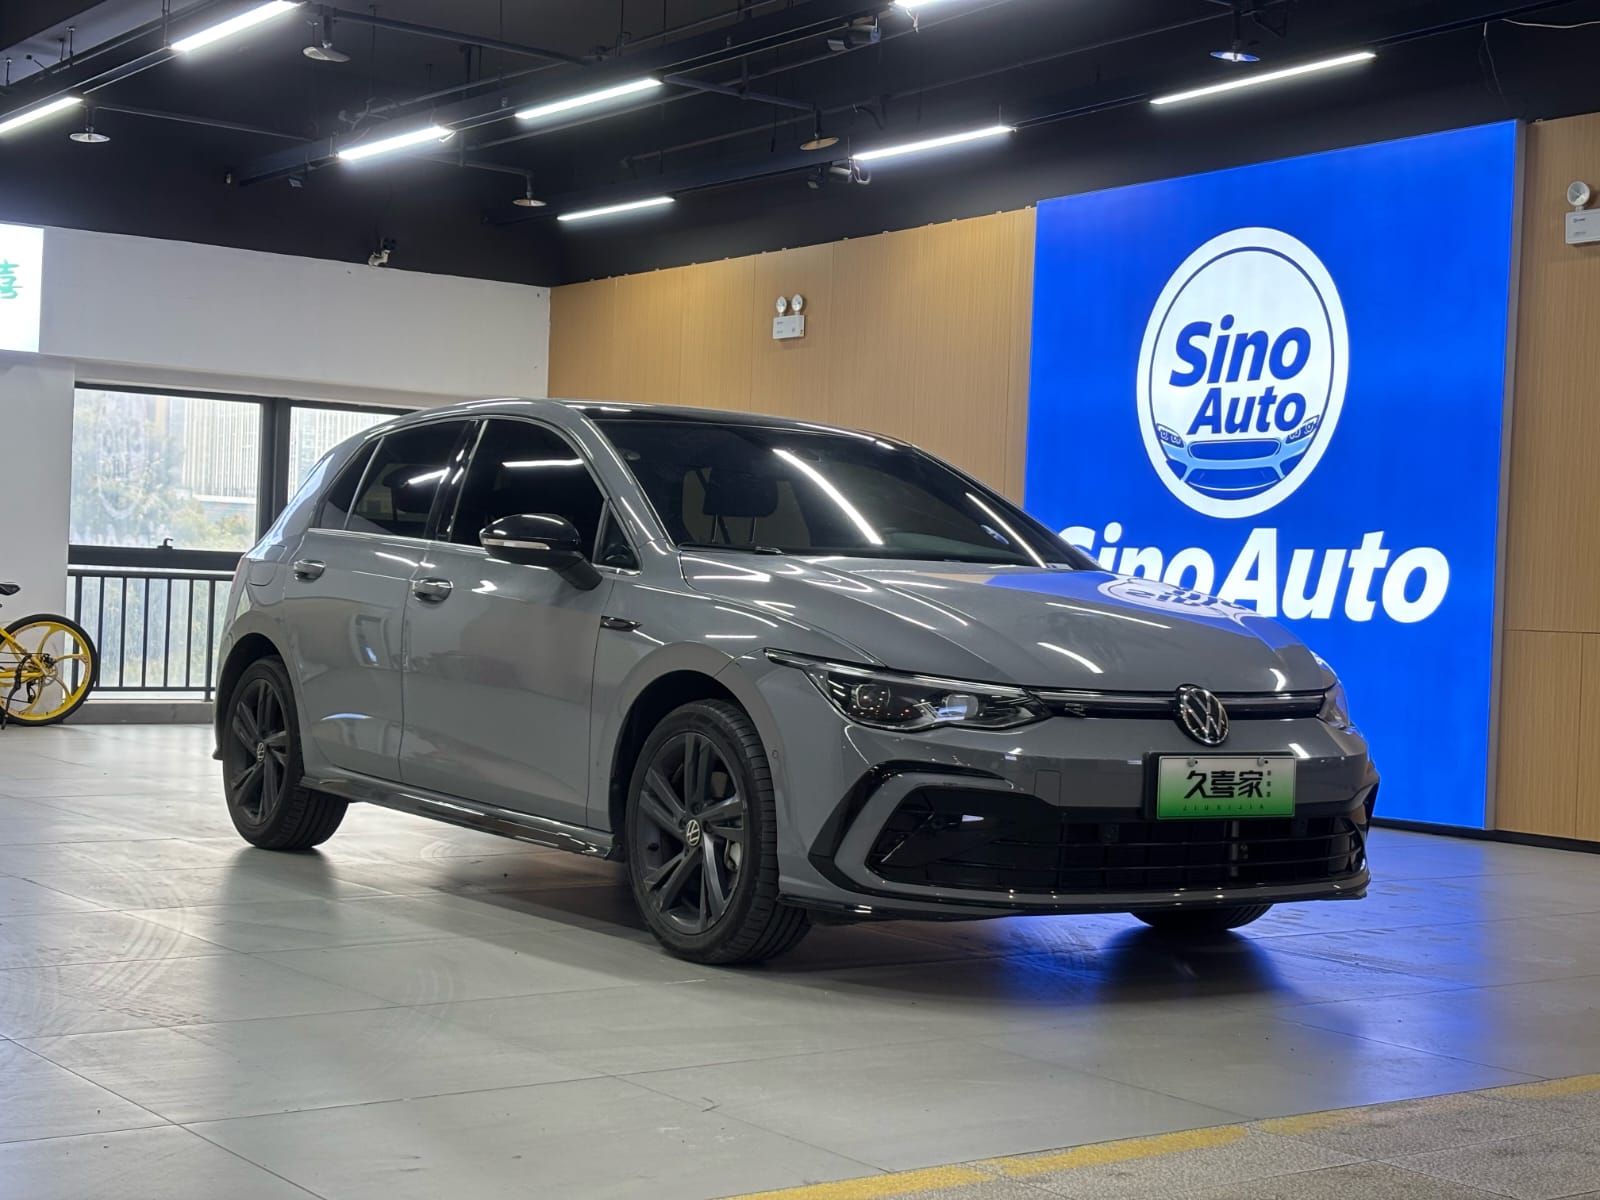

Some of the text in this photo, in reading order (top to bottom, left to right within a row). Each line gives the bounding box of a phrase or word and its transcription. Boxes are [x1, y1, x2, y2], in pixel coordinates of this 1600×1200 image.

[1169, 314, 1311, 387] Sino
[1186, 386, 1306, 436] Auto
[1184, 770, 1263, 798] 久喜家
